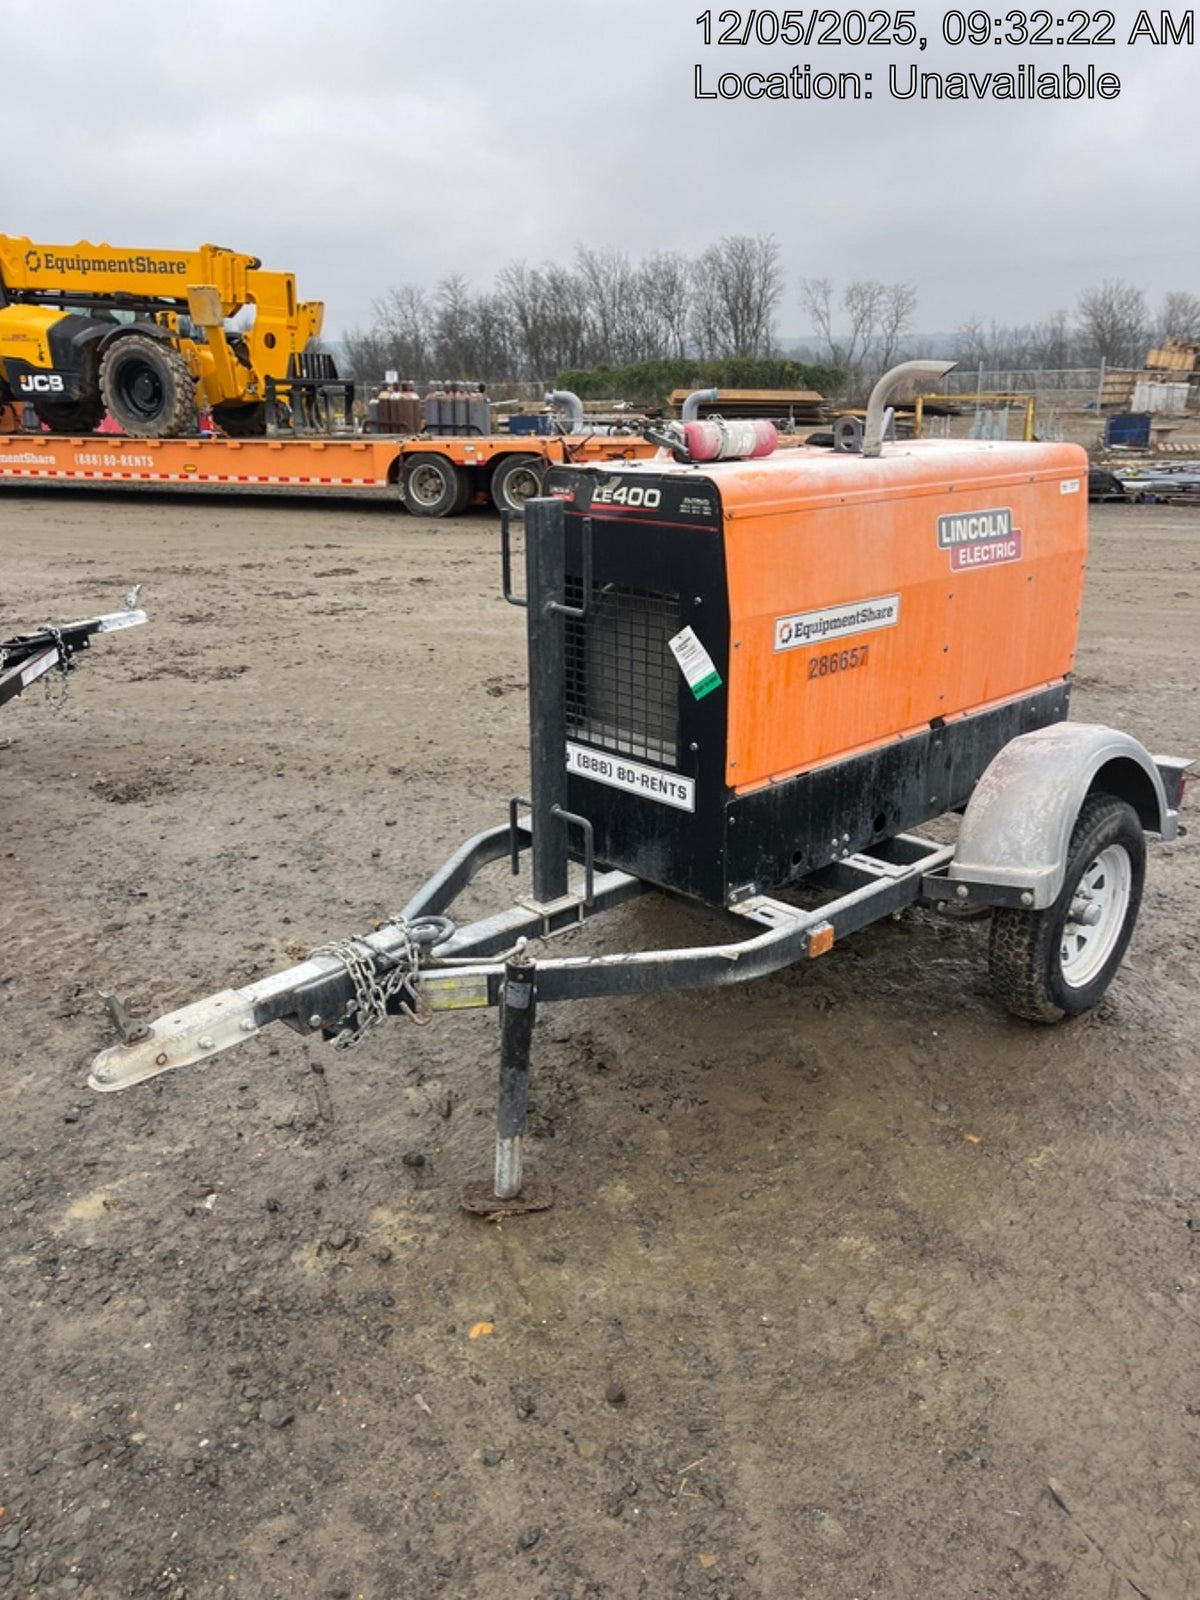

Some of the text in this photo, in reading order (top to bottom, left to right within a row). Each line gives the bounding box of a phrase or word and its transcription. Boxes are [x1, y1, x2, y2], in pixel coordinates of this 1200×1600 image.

[44, 253, 188, 276] EquipmentShare
[19, 374, 65, 392] JCB
[592, 486, 662, 508] LE400
[941, 513, 1009, 544] LINCOLN
[959, 541, 1017, 566] ELECTRIC
[794, 605, 894, 639] EquipmentShare
[807, 645, 869, 680] 286657
[576, 752, 688, 801] (888) 80-RENTS
